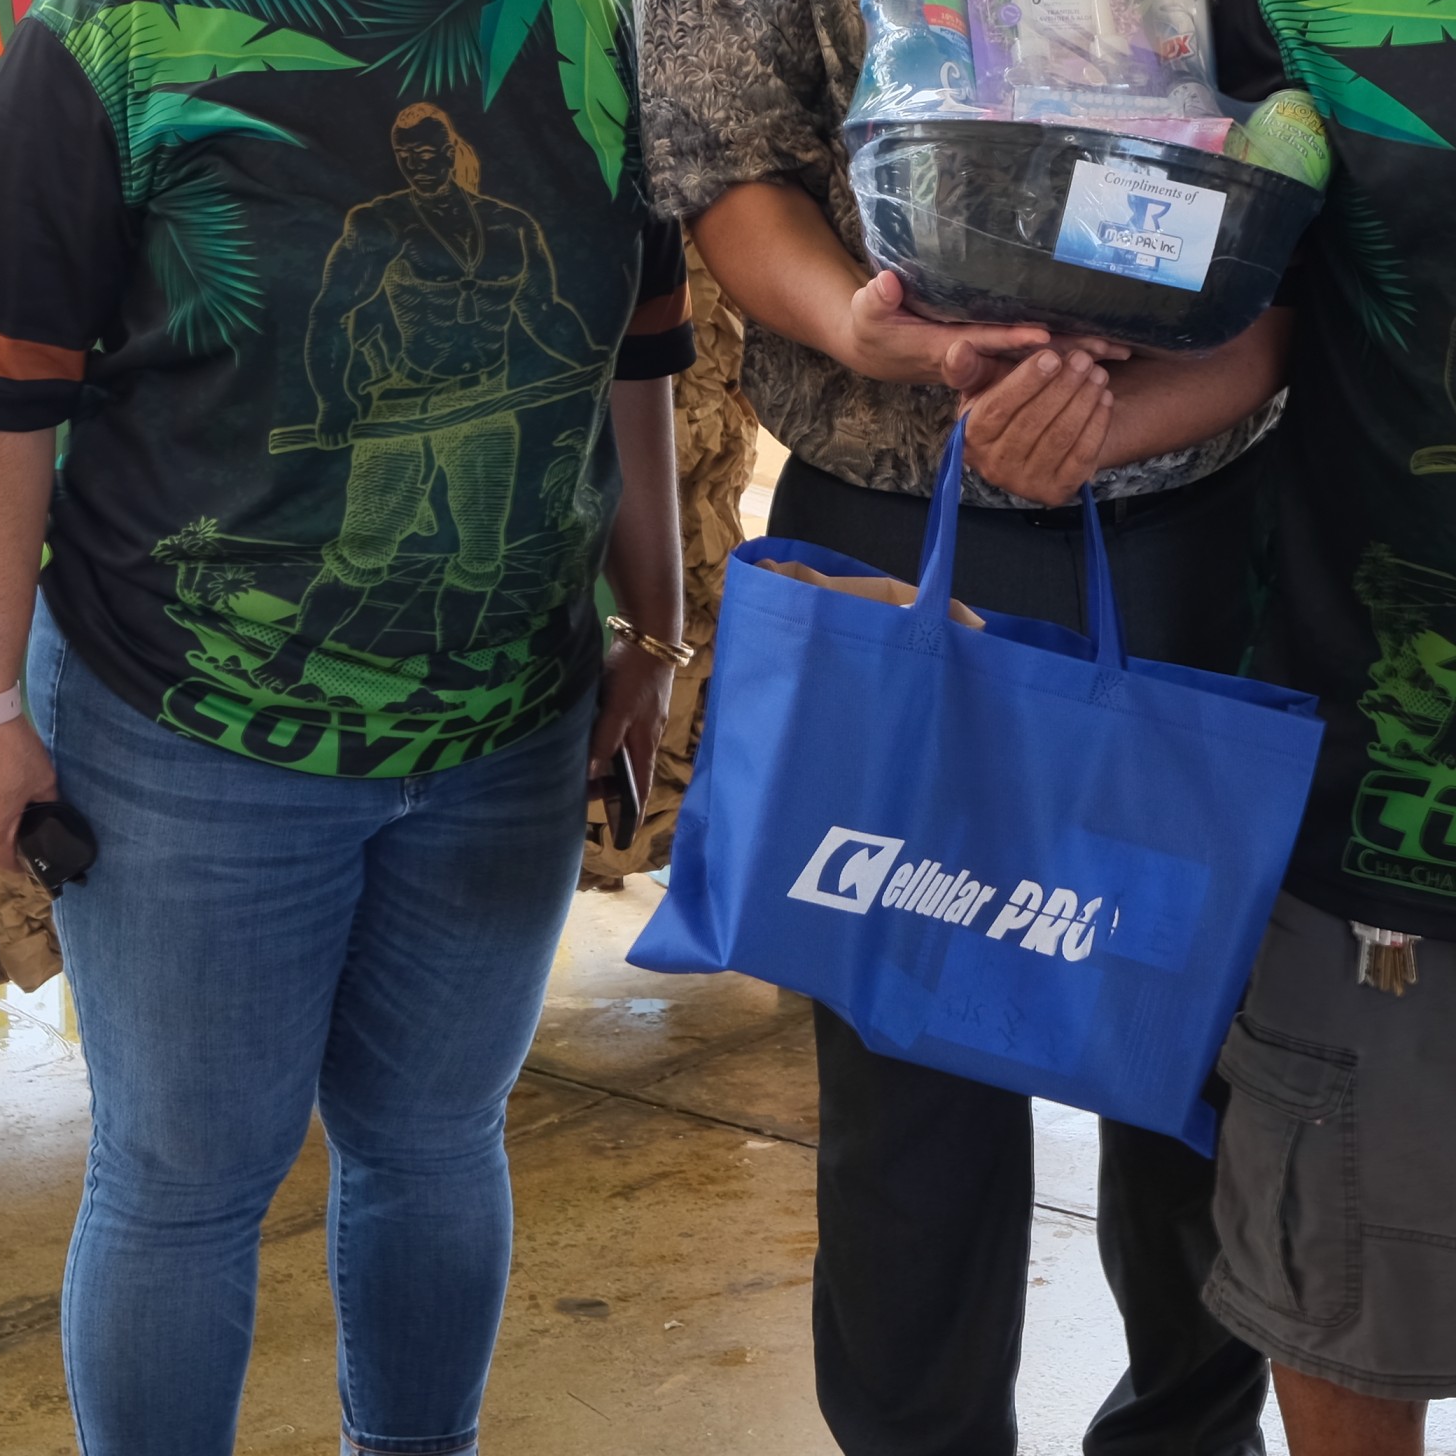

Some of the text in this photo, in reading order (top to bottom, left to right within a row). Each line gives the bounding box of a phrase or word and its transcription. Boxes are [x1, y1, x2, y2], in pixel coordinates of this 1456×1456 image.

[1104, 171, 1200, 205] Compliments of
[1159, 240, 1177, 255] Inc.
[787, 825, 997, 927] Cellular
